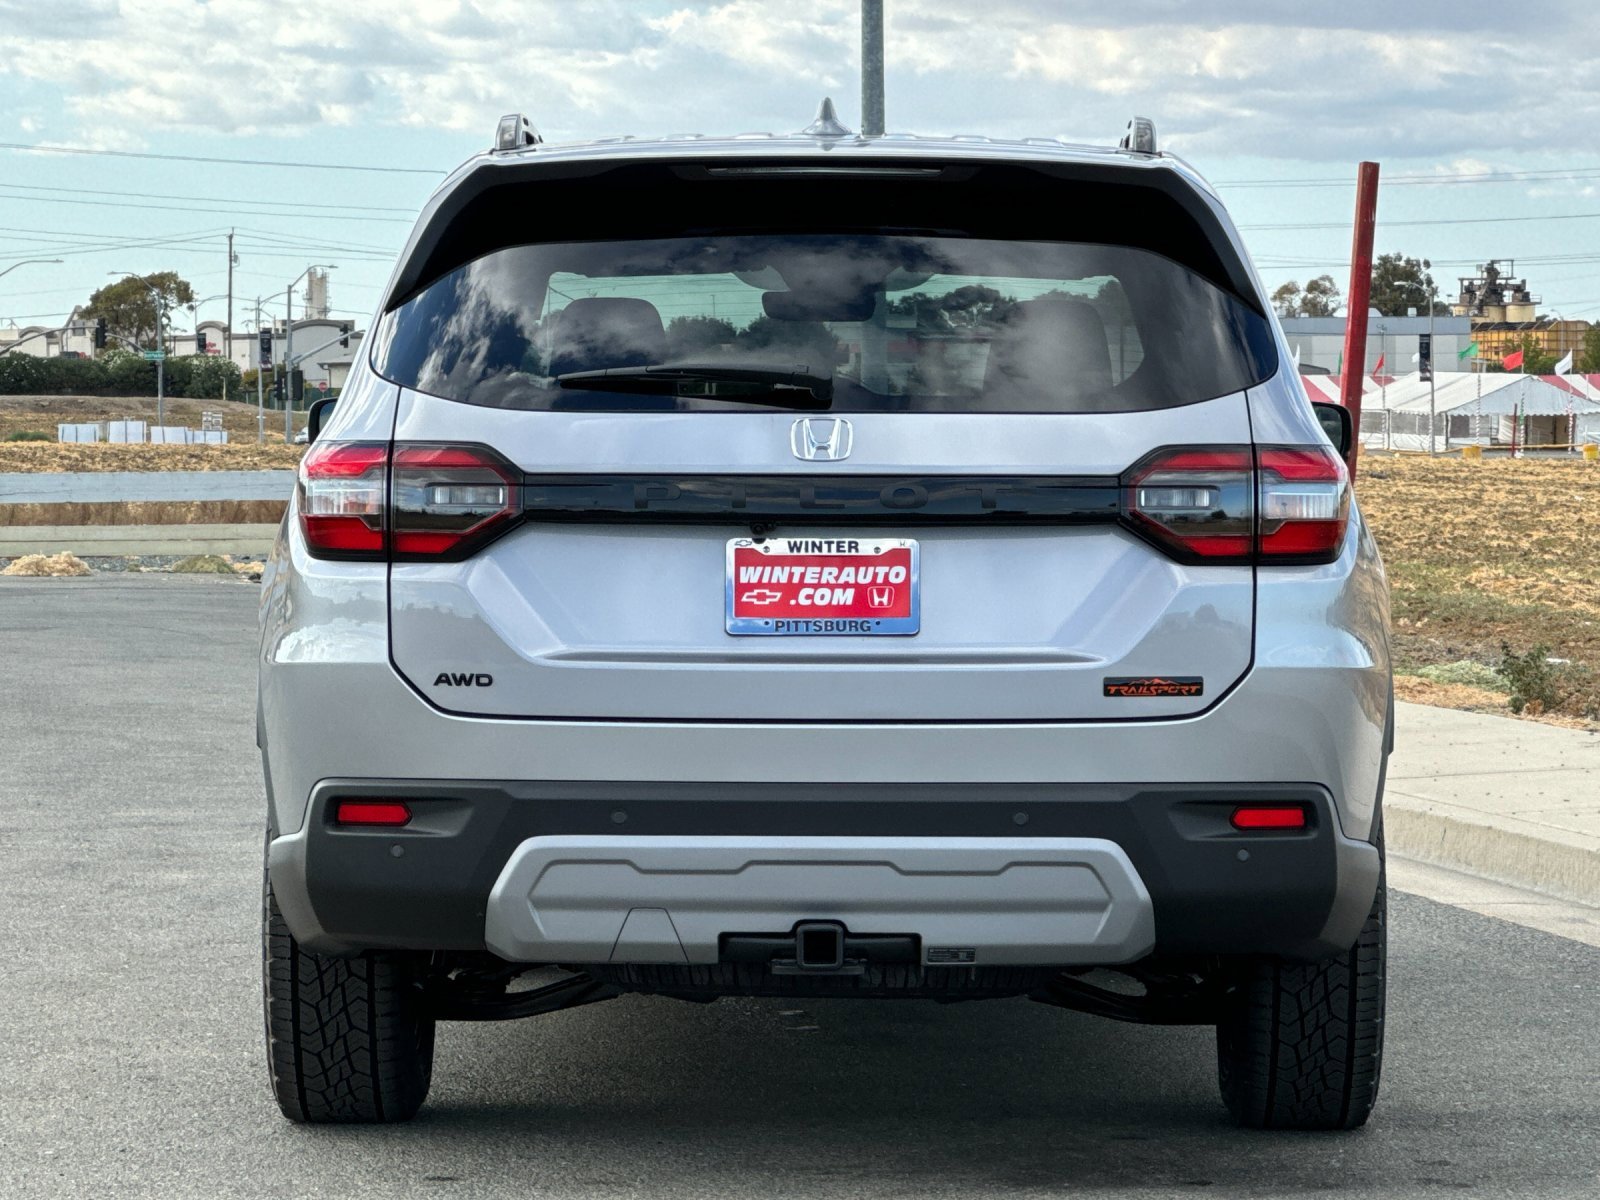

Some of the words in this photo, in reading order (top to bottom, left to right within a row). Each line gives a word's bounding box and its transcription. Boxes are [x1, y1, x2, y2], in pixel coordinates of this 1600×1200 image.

[634, 483, 1012, 509] PILOT
[787, 540, 860, 554] WINTER
[739, 566, 907, 584] WINTERAUTO
[789, 587, 855, 606] .COM
[774, 620, 872, 633] PITTSBURG
[433, 672, 494, 687] AWD
[1107, 685, 1201, 695] TRAILSPORT
